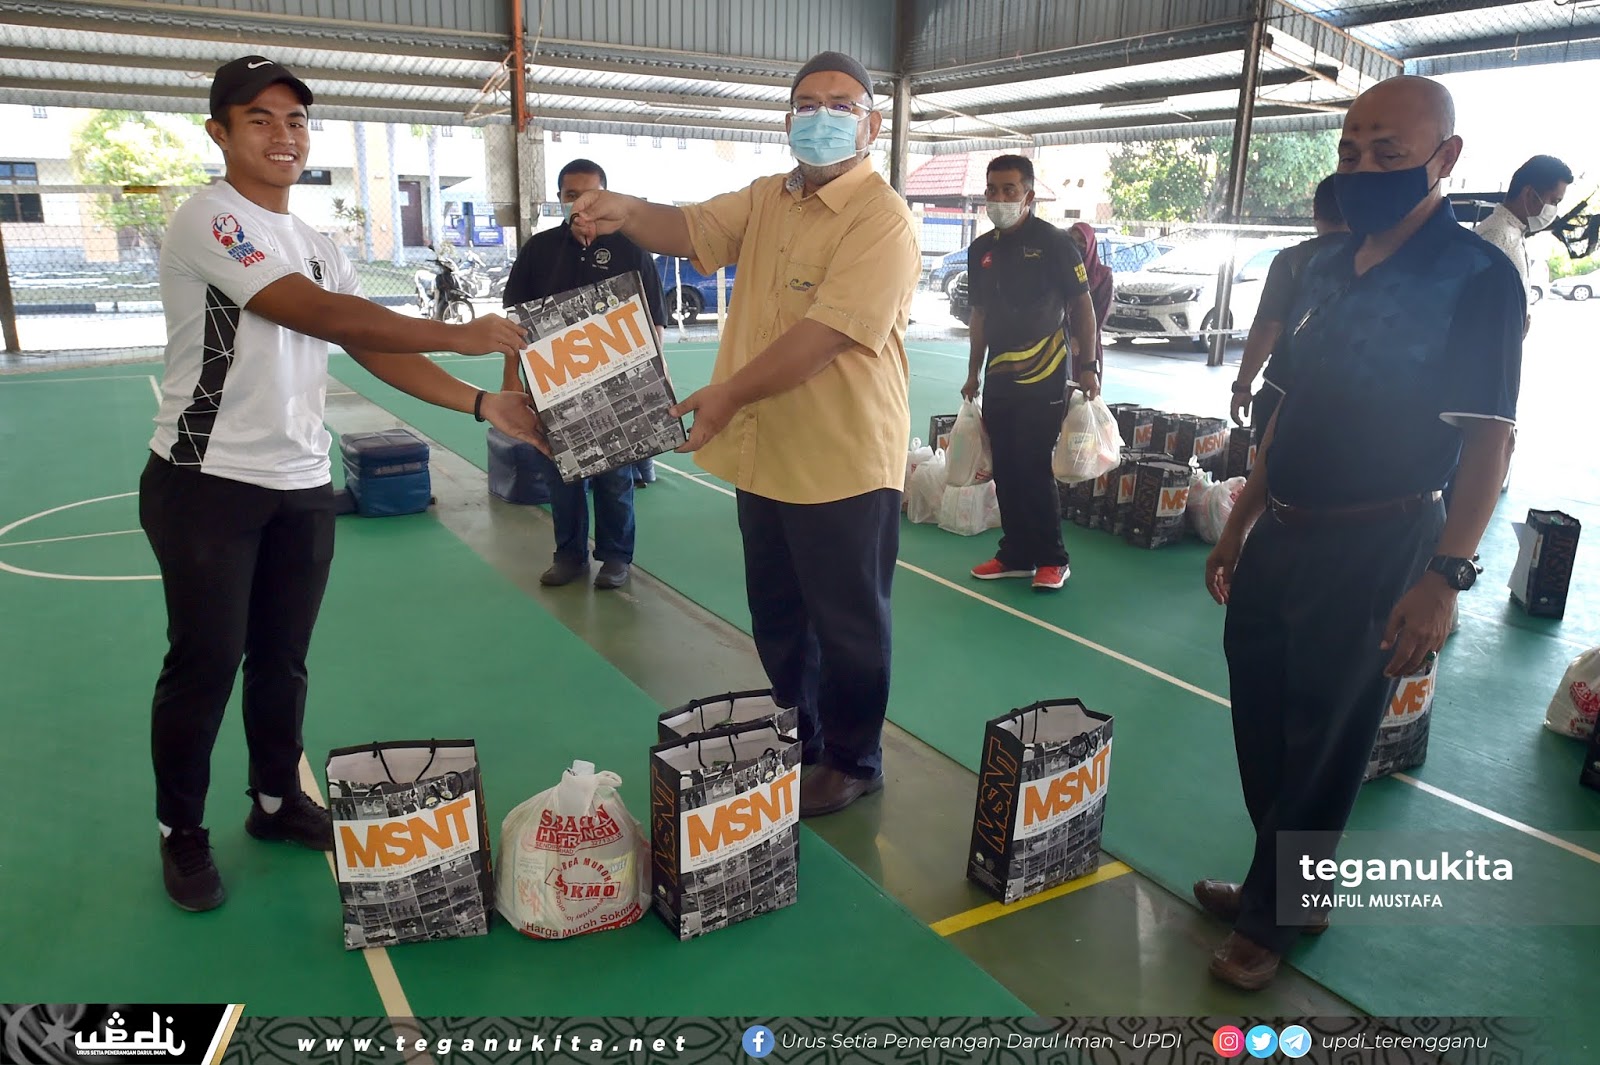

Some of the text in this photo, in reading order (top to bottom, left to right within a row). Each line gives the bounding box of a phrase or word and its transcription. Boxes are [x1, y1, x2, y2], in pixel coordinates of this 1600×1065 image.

[238, 250, 266, 268] 2019
[525, 301, 647, 395] MSNT
[651, 764, 679, 886] MSNT
[686, 771, 797, 858] MSNT
[977, 736, 1018, 855] MSNT
[1023, 745, 1110, 827] MSNT
[339, 797, 472, 868] MSNT
[562, 919, 597, 937] Muroh
